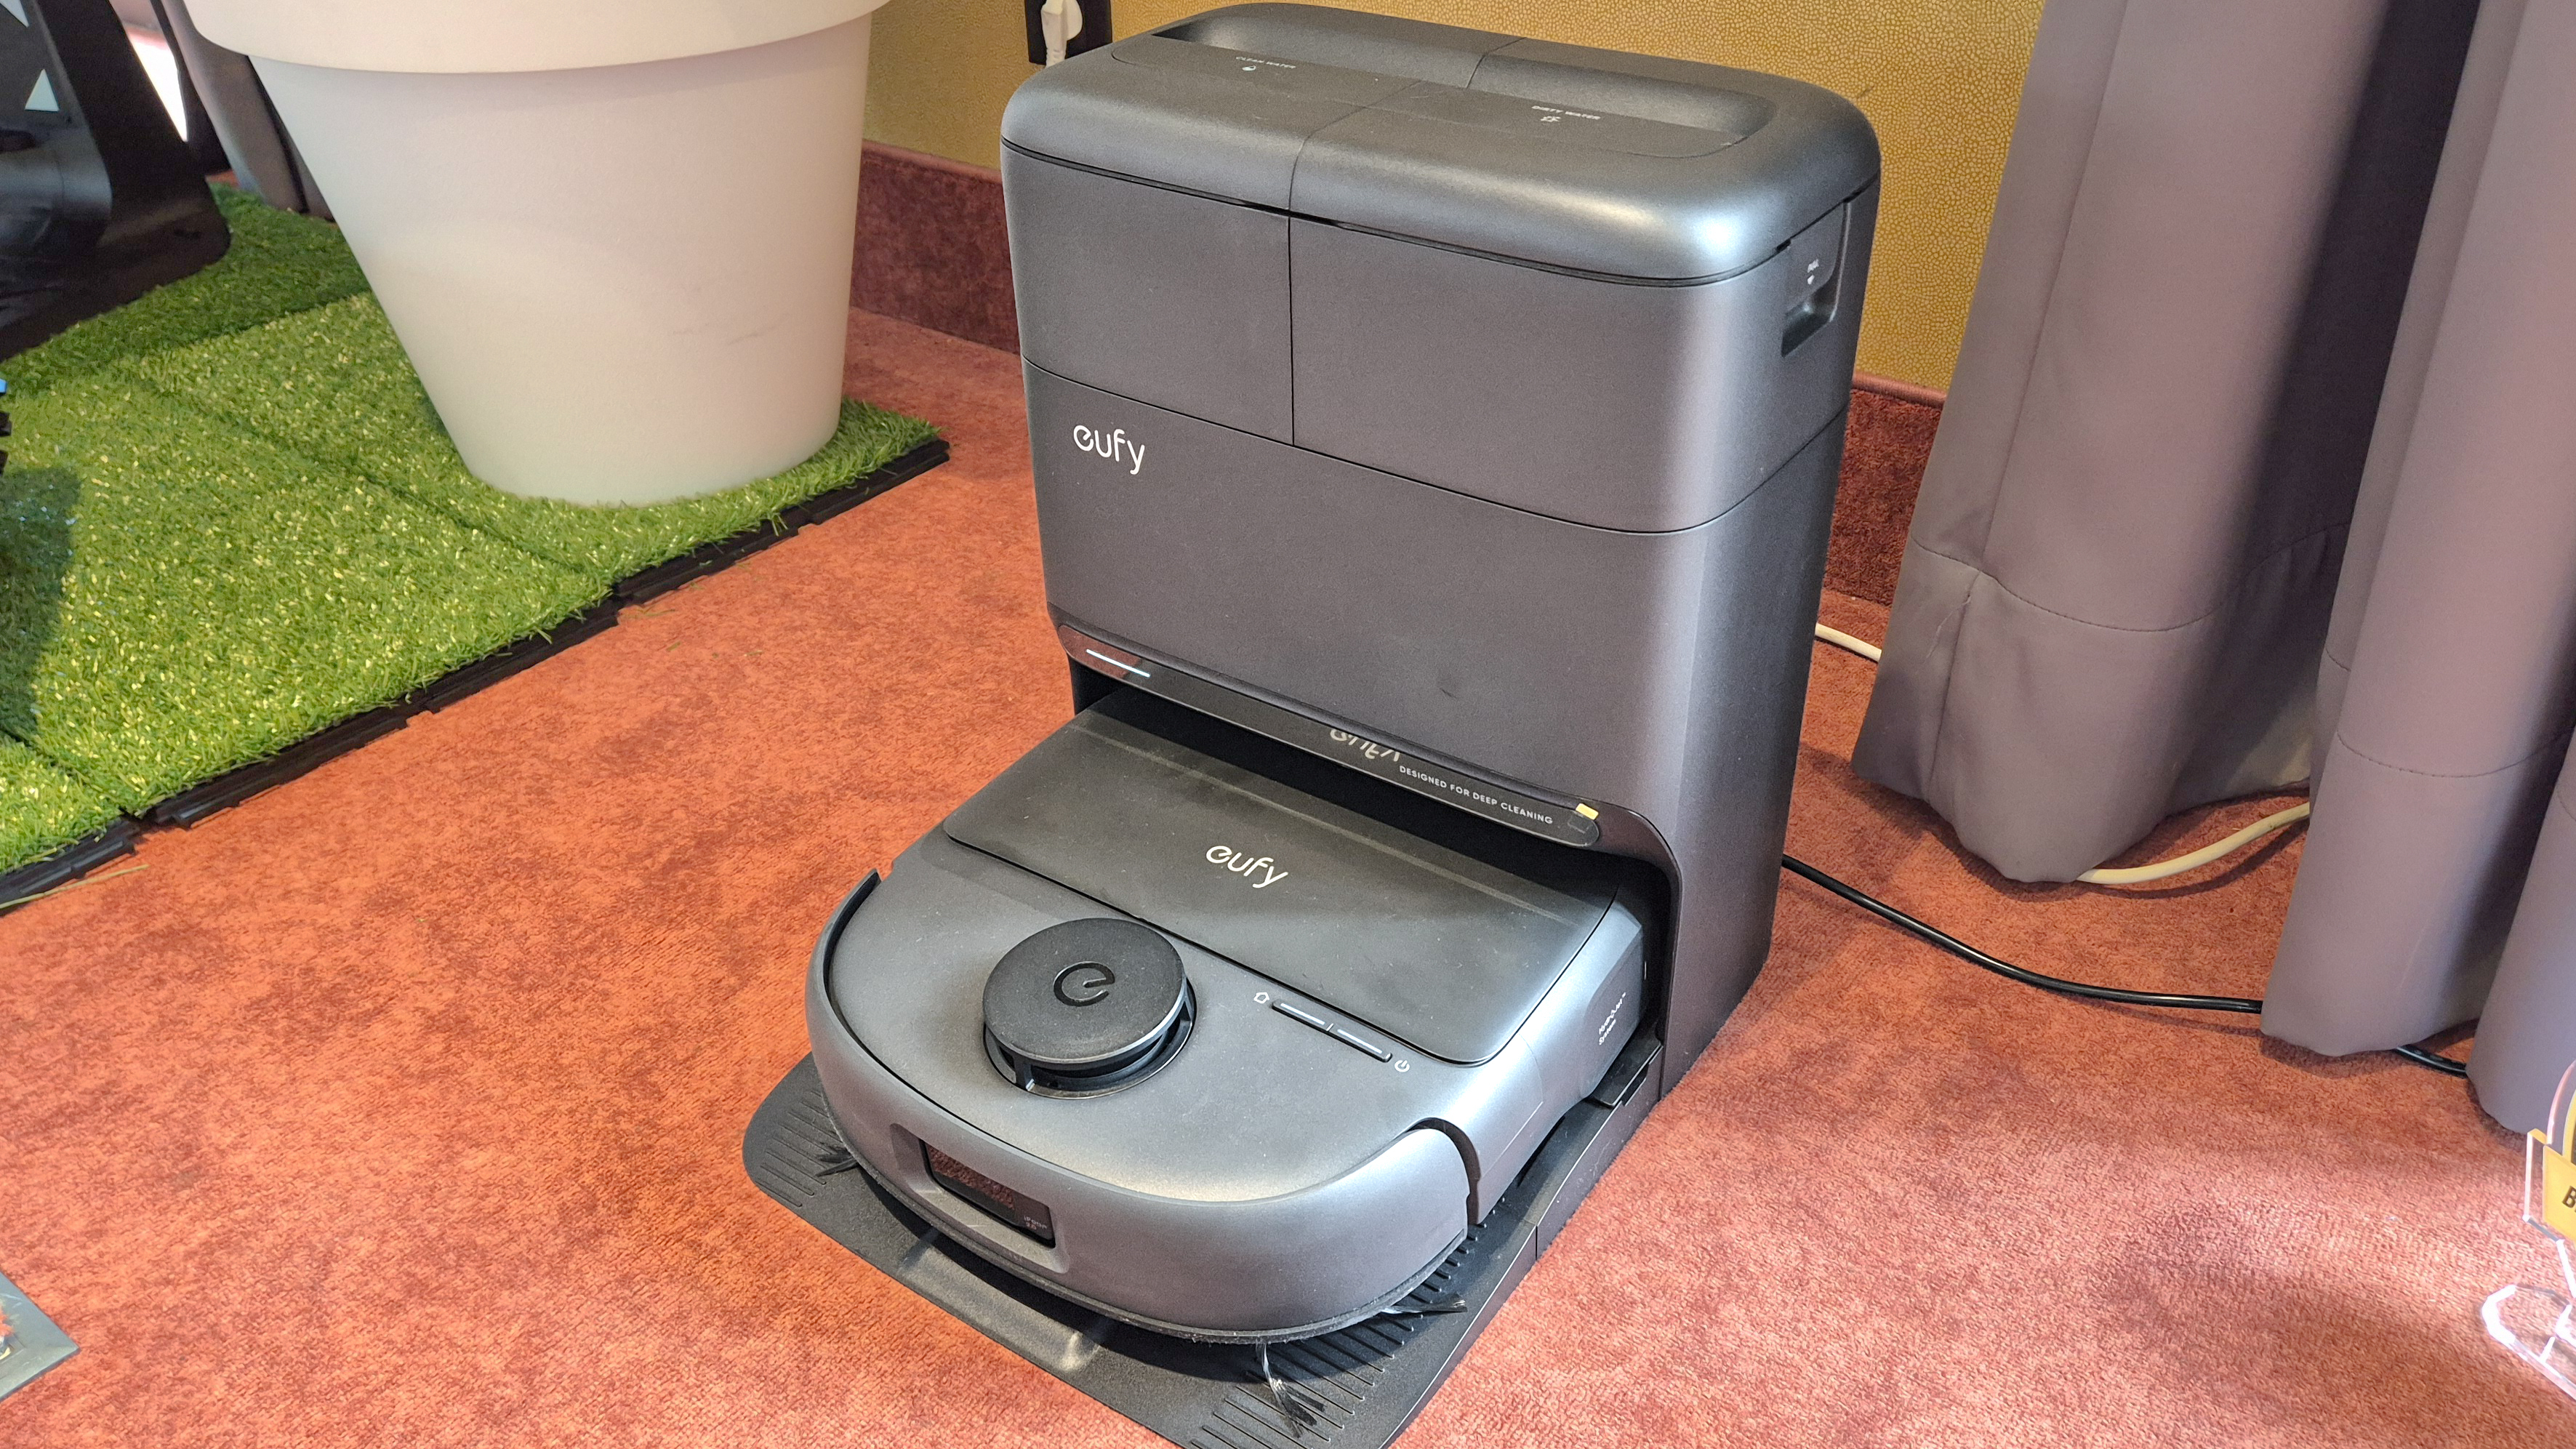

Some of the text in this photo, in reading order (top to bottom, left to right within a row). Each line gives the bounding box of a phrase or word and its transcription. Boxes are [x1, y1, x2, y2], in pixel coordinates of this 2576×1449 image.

[1073, 425, 1145, 475] eufy
[1399, 765, 1553, 824] DESIGNED FOR DEEP CLEANING
[1205, 846, 1288, 888] eufy
